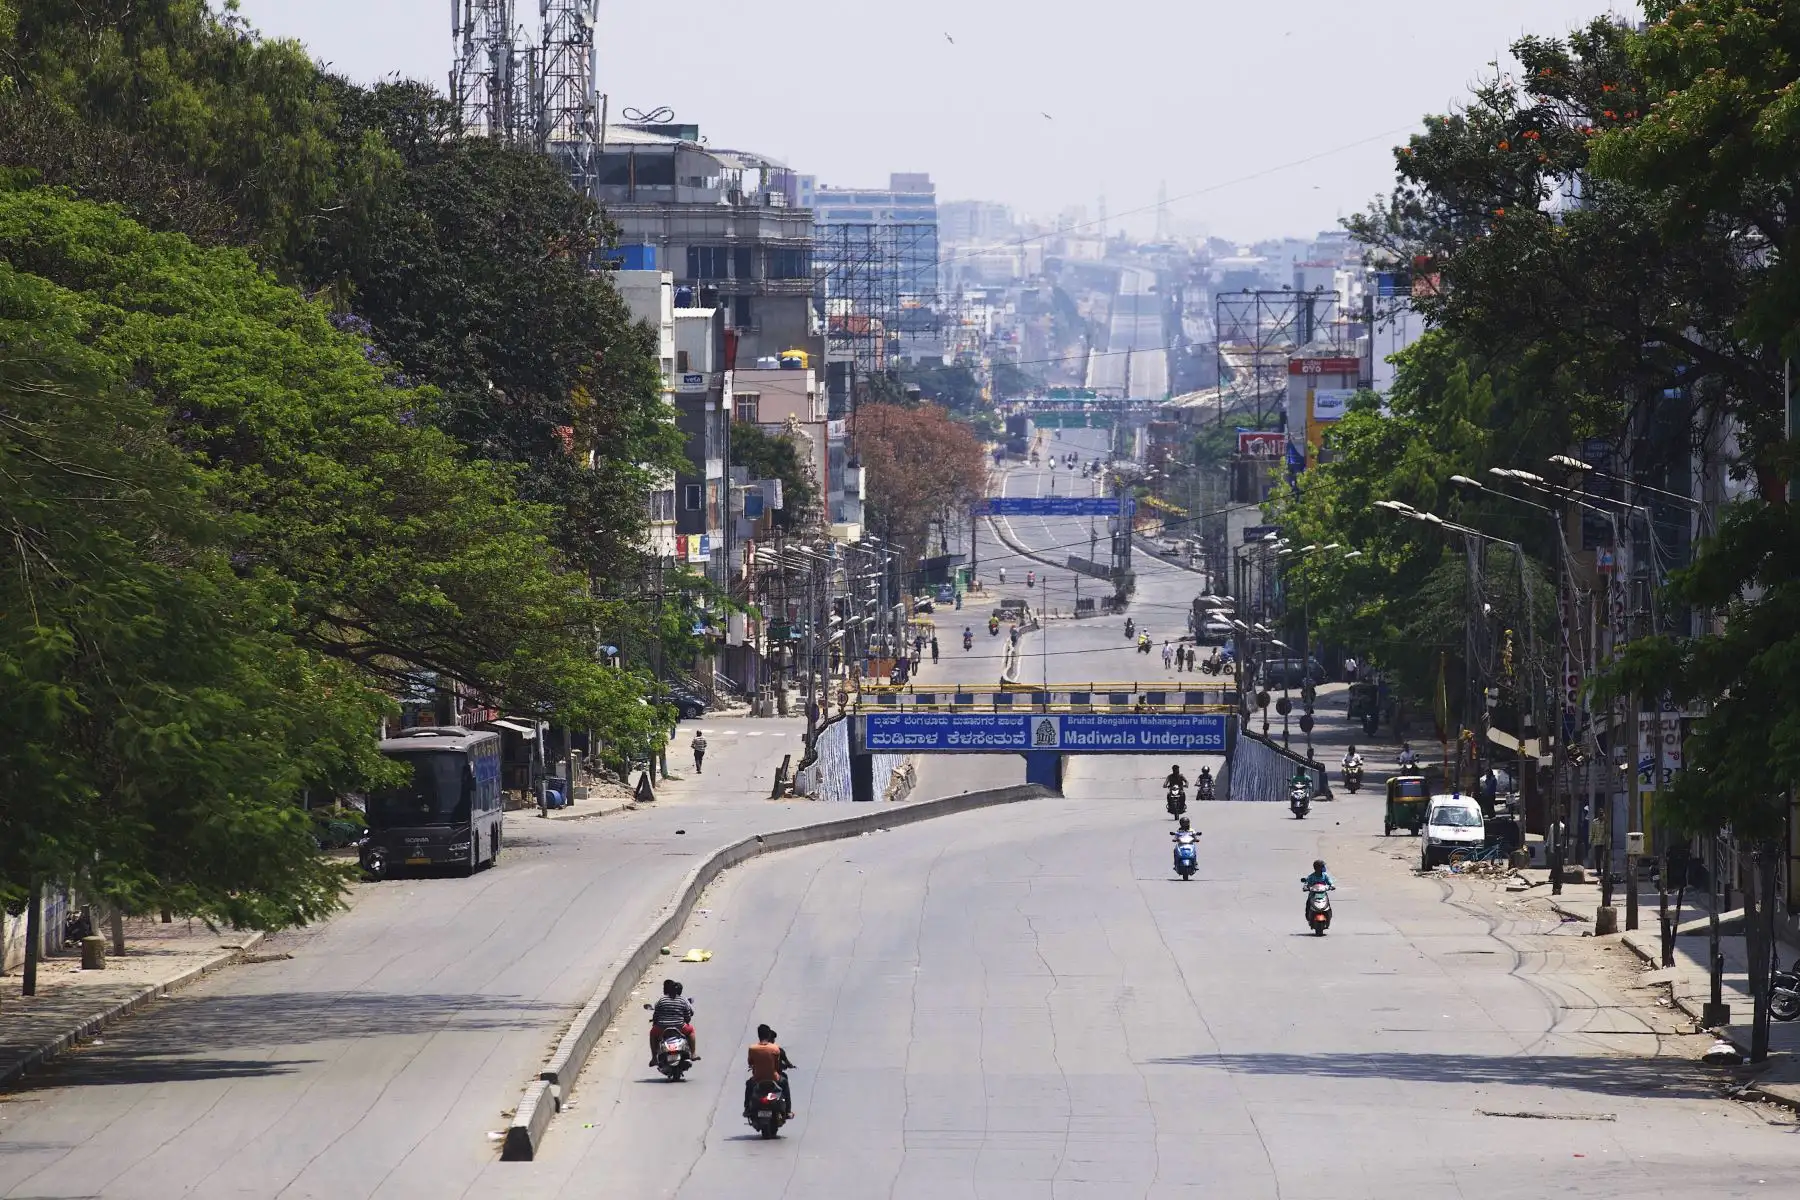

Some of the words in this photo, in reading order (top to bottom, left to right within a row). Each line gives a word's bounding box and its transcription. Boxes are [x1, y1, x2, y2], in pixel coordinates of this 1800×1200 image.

[1302, 365, 1321, 373] OYO
[1067, 716, 1095, 725] Bruhat
[1097, 716, 1138, 726] Bengaluru
[1141, 717, 1190, 727] Mahanagara
[1192, 717, 1218, 725] Palike
[872, 731, 938, 745] ಮಡಿವಾಳ
[1064, 730, 1136, 745] Madiwala
[1141, 731, 1221, 748] Underpass
